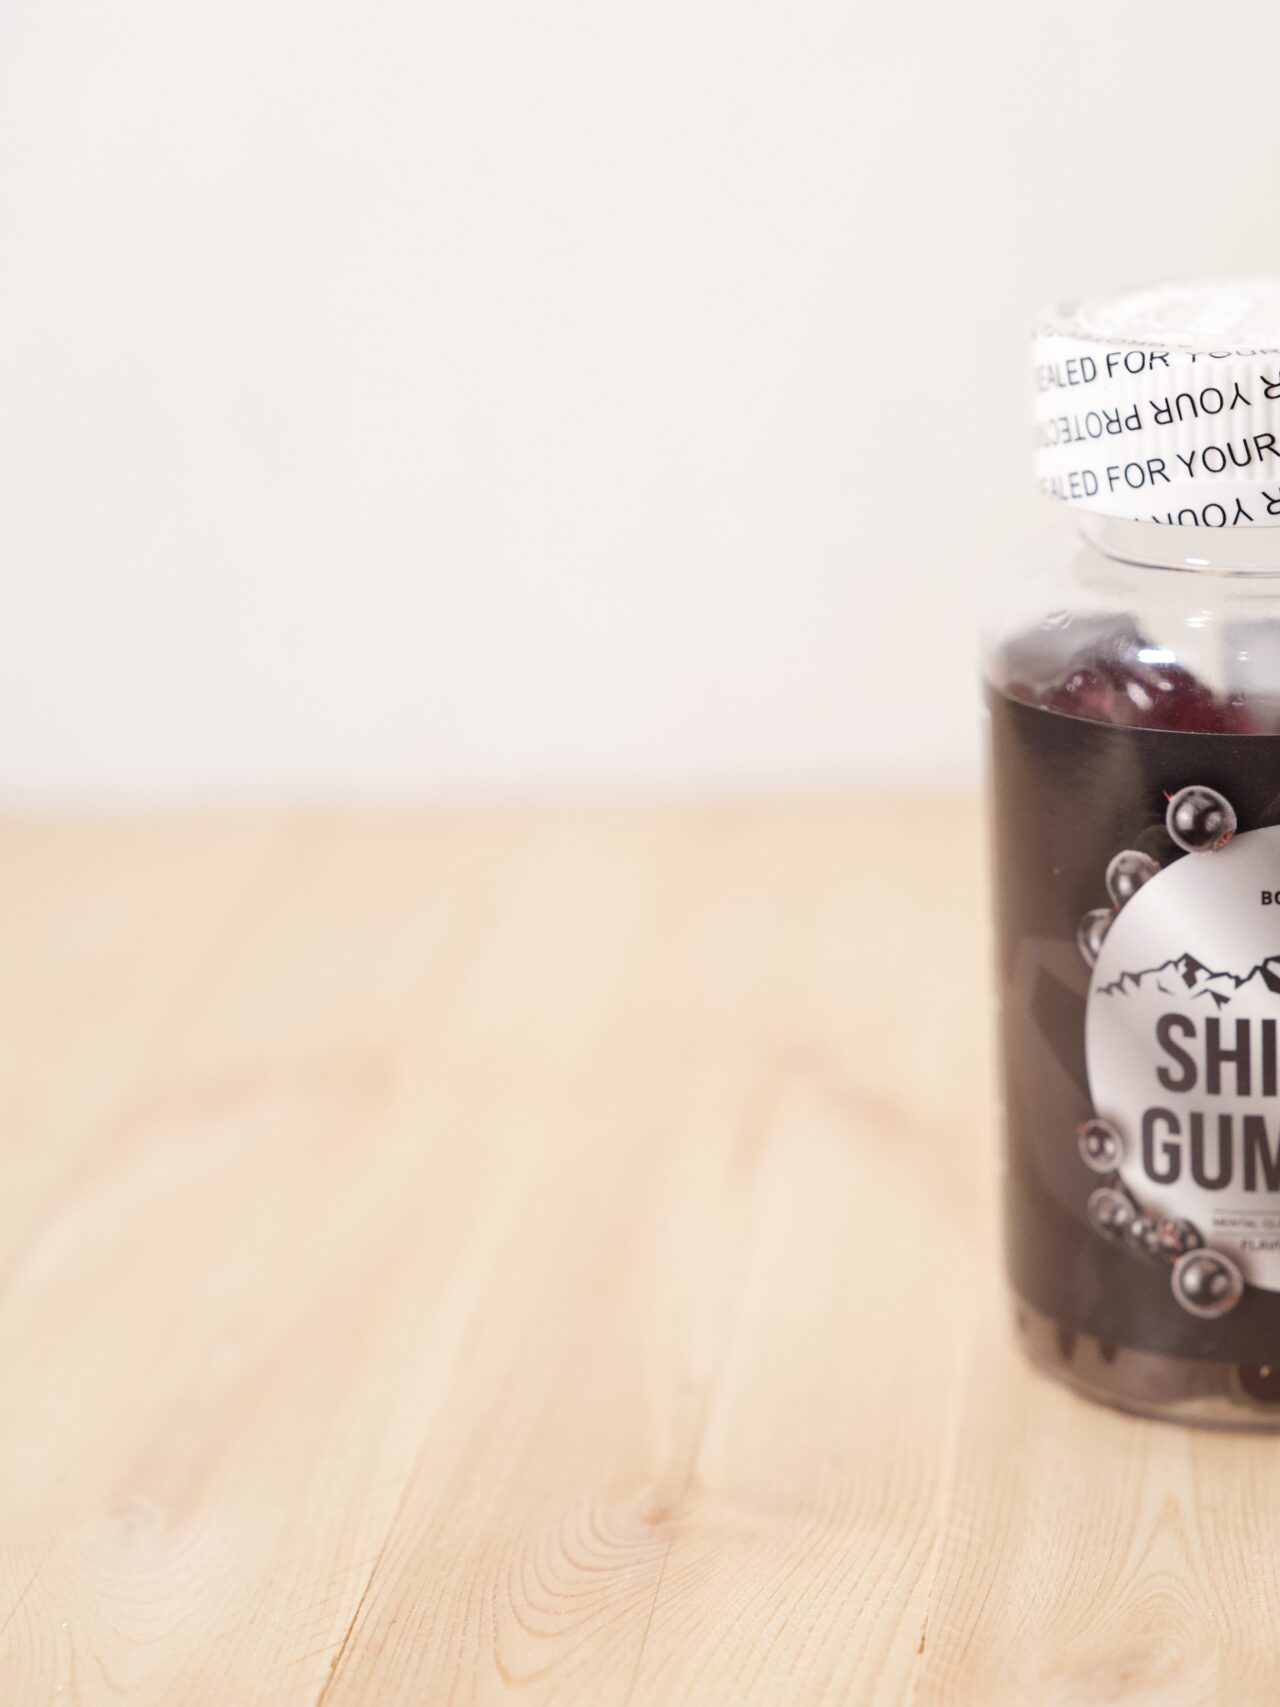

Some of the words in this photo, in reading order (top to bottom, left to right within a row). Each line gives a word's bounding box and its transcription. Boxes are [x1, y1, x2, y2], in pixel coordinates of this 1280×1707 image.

[1106, 350, 1170, 379] FOR
[1149, 382, 1252, 426] YOUR
[1106, 458, 1171, 492] FOR
